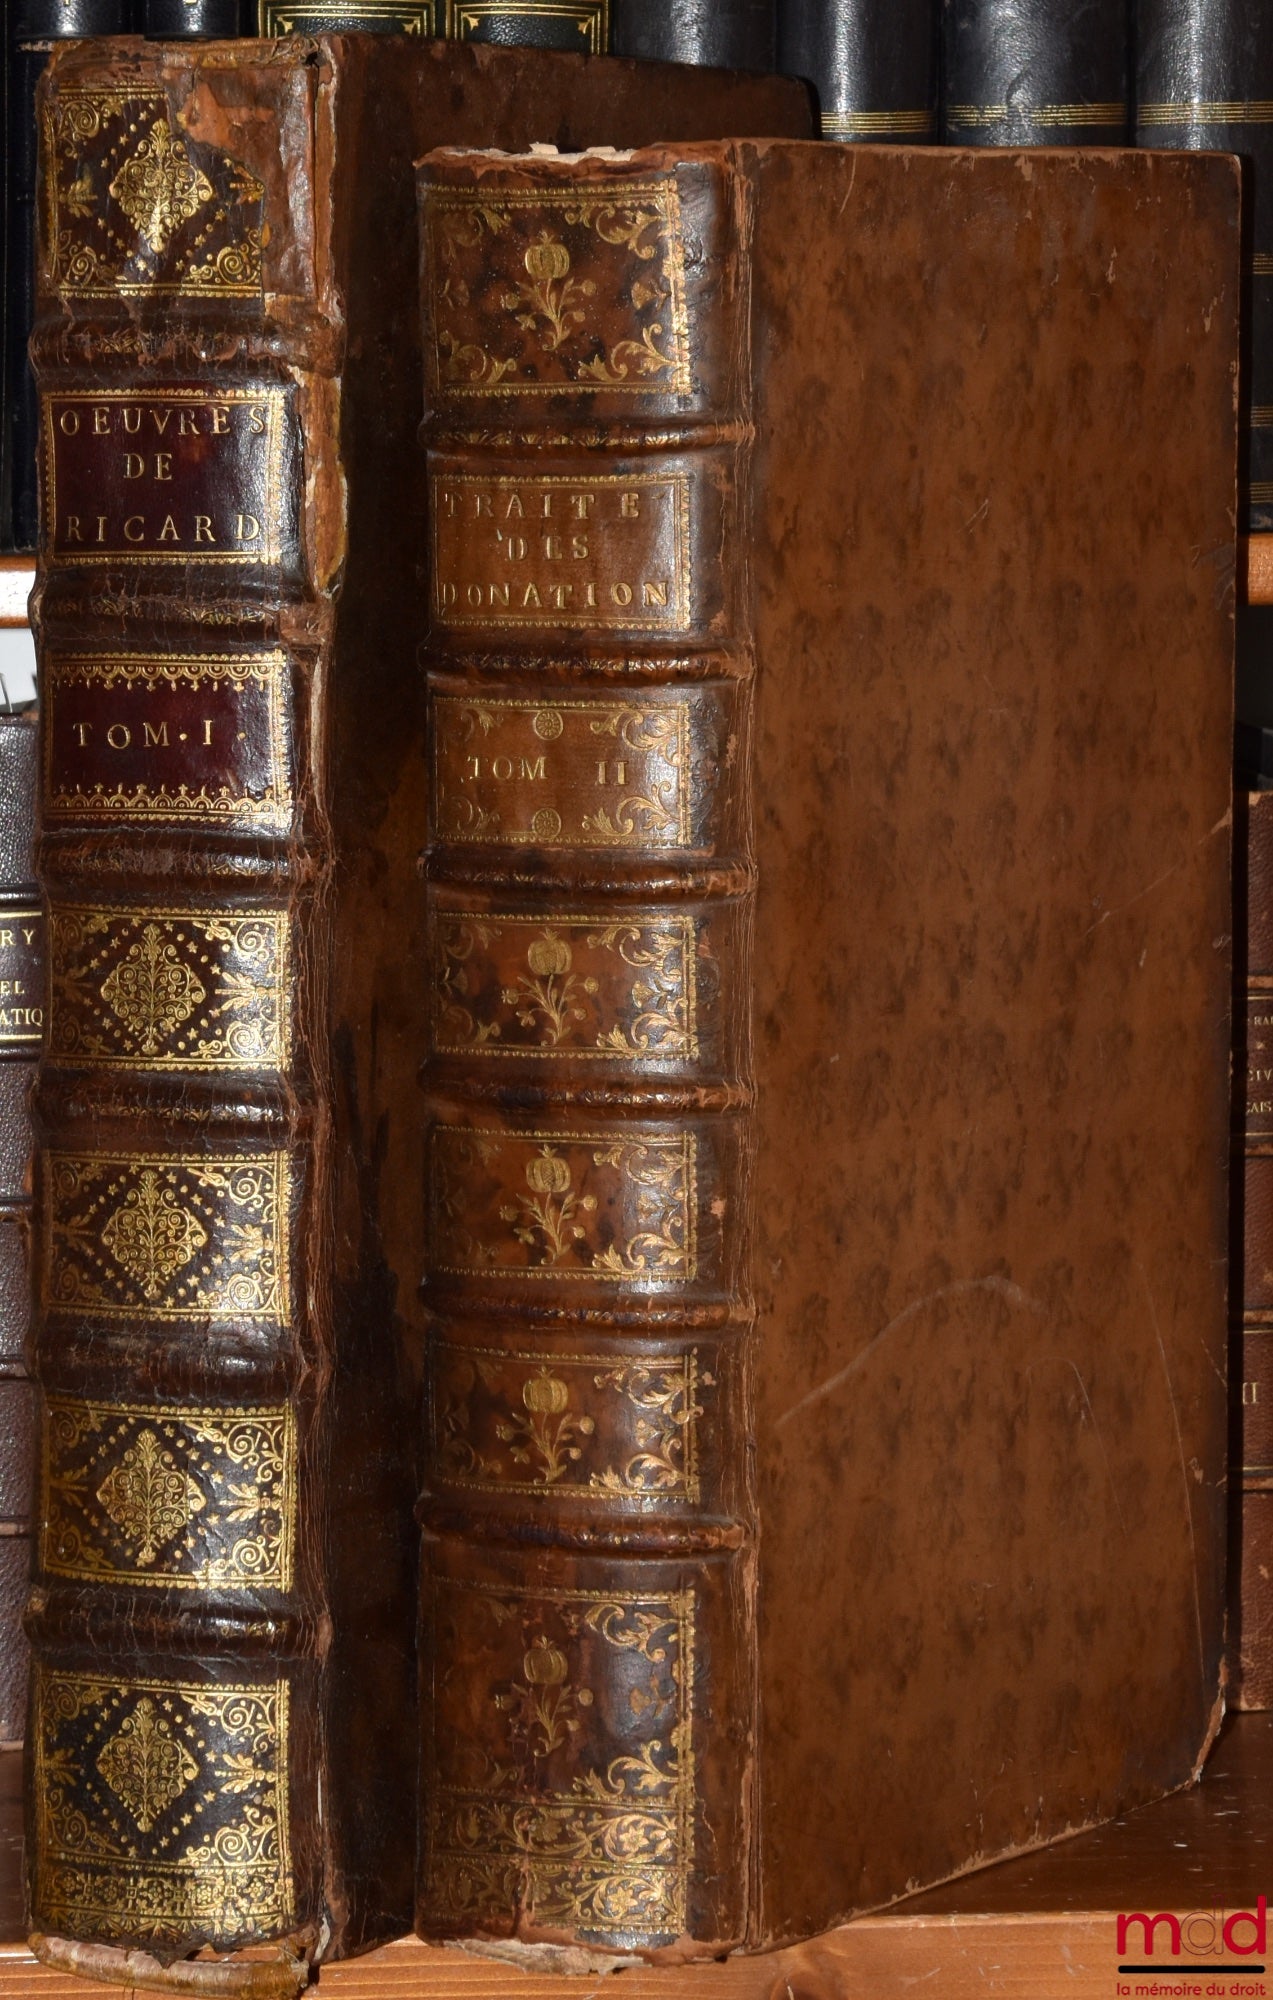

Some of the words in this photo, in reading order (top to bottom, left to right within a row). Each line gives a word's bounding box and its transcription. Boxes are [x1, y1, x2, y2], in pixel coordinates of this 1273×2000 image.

[60, 405, 268, 437] OEUVRES
[123, 453, 173, 481] DE
[66, 513, 261, 543] RICARD
[506, 535, 590, 561] DES
[441, 581, 669, 610] DONATION
[467, 756, 548, 781] TOM
[594, 760, 629, 786] II
